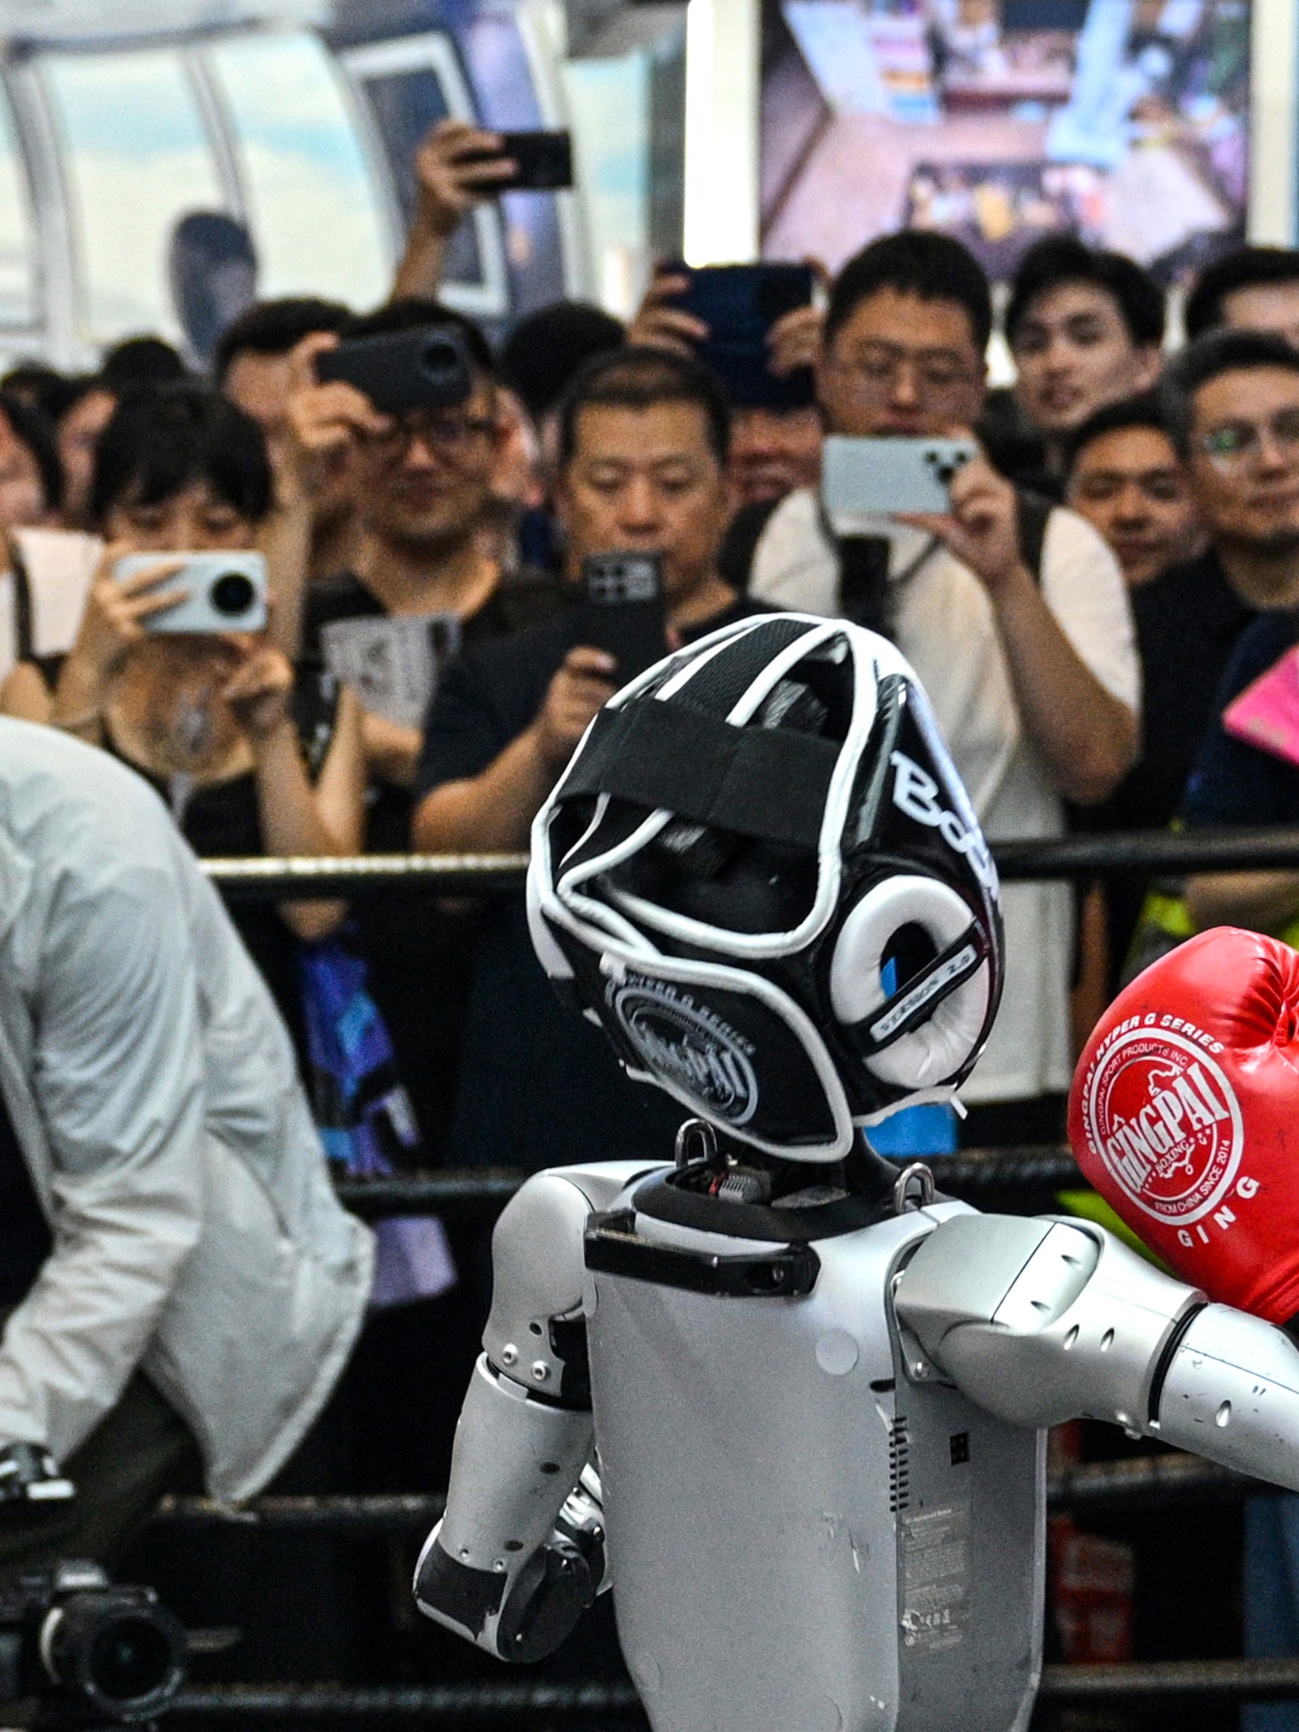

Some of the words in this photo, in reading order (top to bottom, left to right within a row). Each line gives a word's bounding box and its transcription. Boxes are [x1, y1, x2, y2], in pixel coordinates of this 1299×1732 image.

[946, 954, 971, 976] 2.0
[1096, 1014, 1141, 1061] HYPER
[1144, 1012, 1157, 1025] G
[1160, 1014, 1225, 1054] SERIES
[1102, 1055, 1122, 1087] SPORT
[1122, 1043, 1169, 1060] PRODUCTS
[1106, 1062, 1230, 1194] GINGPAI
[1154, 1201, 1177, 1214] FROM
[1177, 1192, 1203, 1212] CHINA
[1200, 1165, 1223, 1196] SINCE
[1216, 1139, 1231, 1165] 2014
[1155, 1140, 1190, 1174] BOXING
